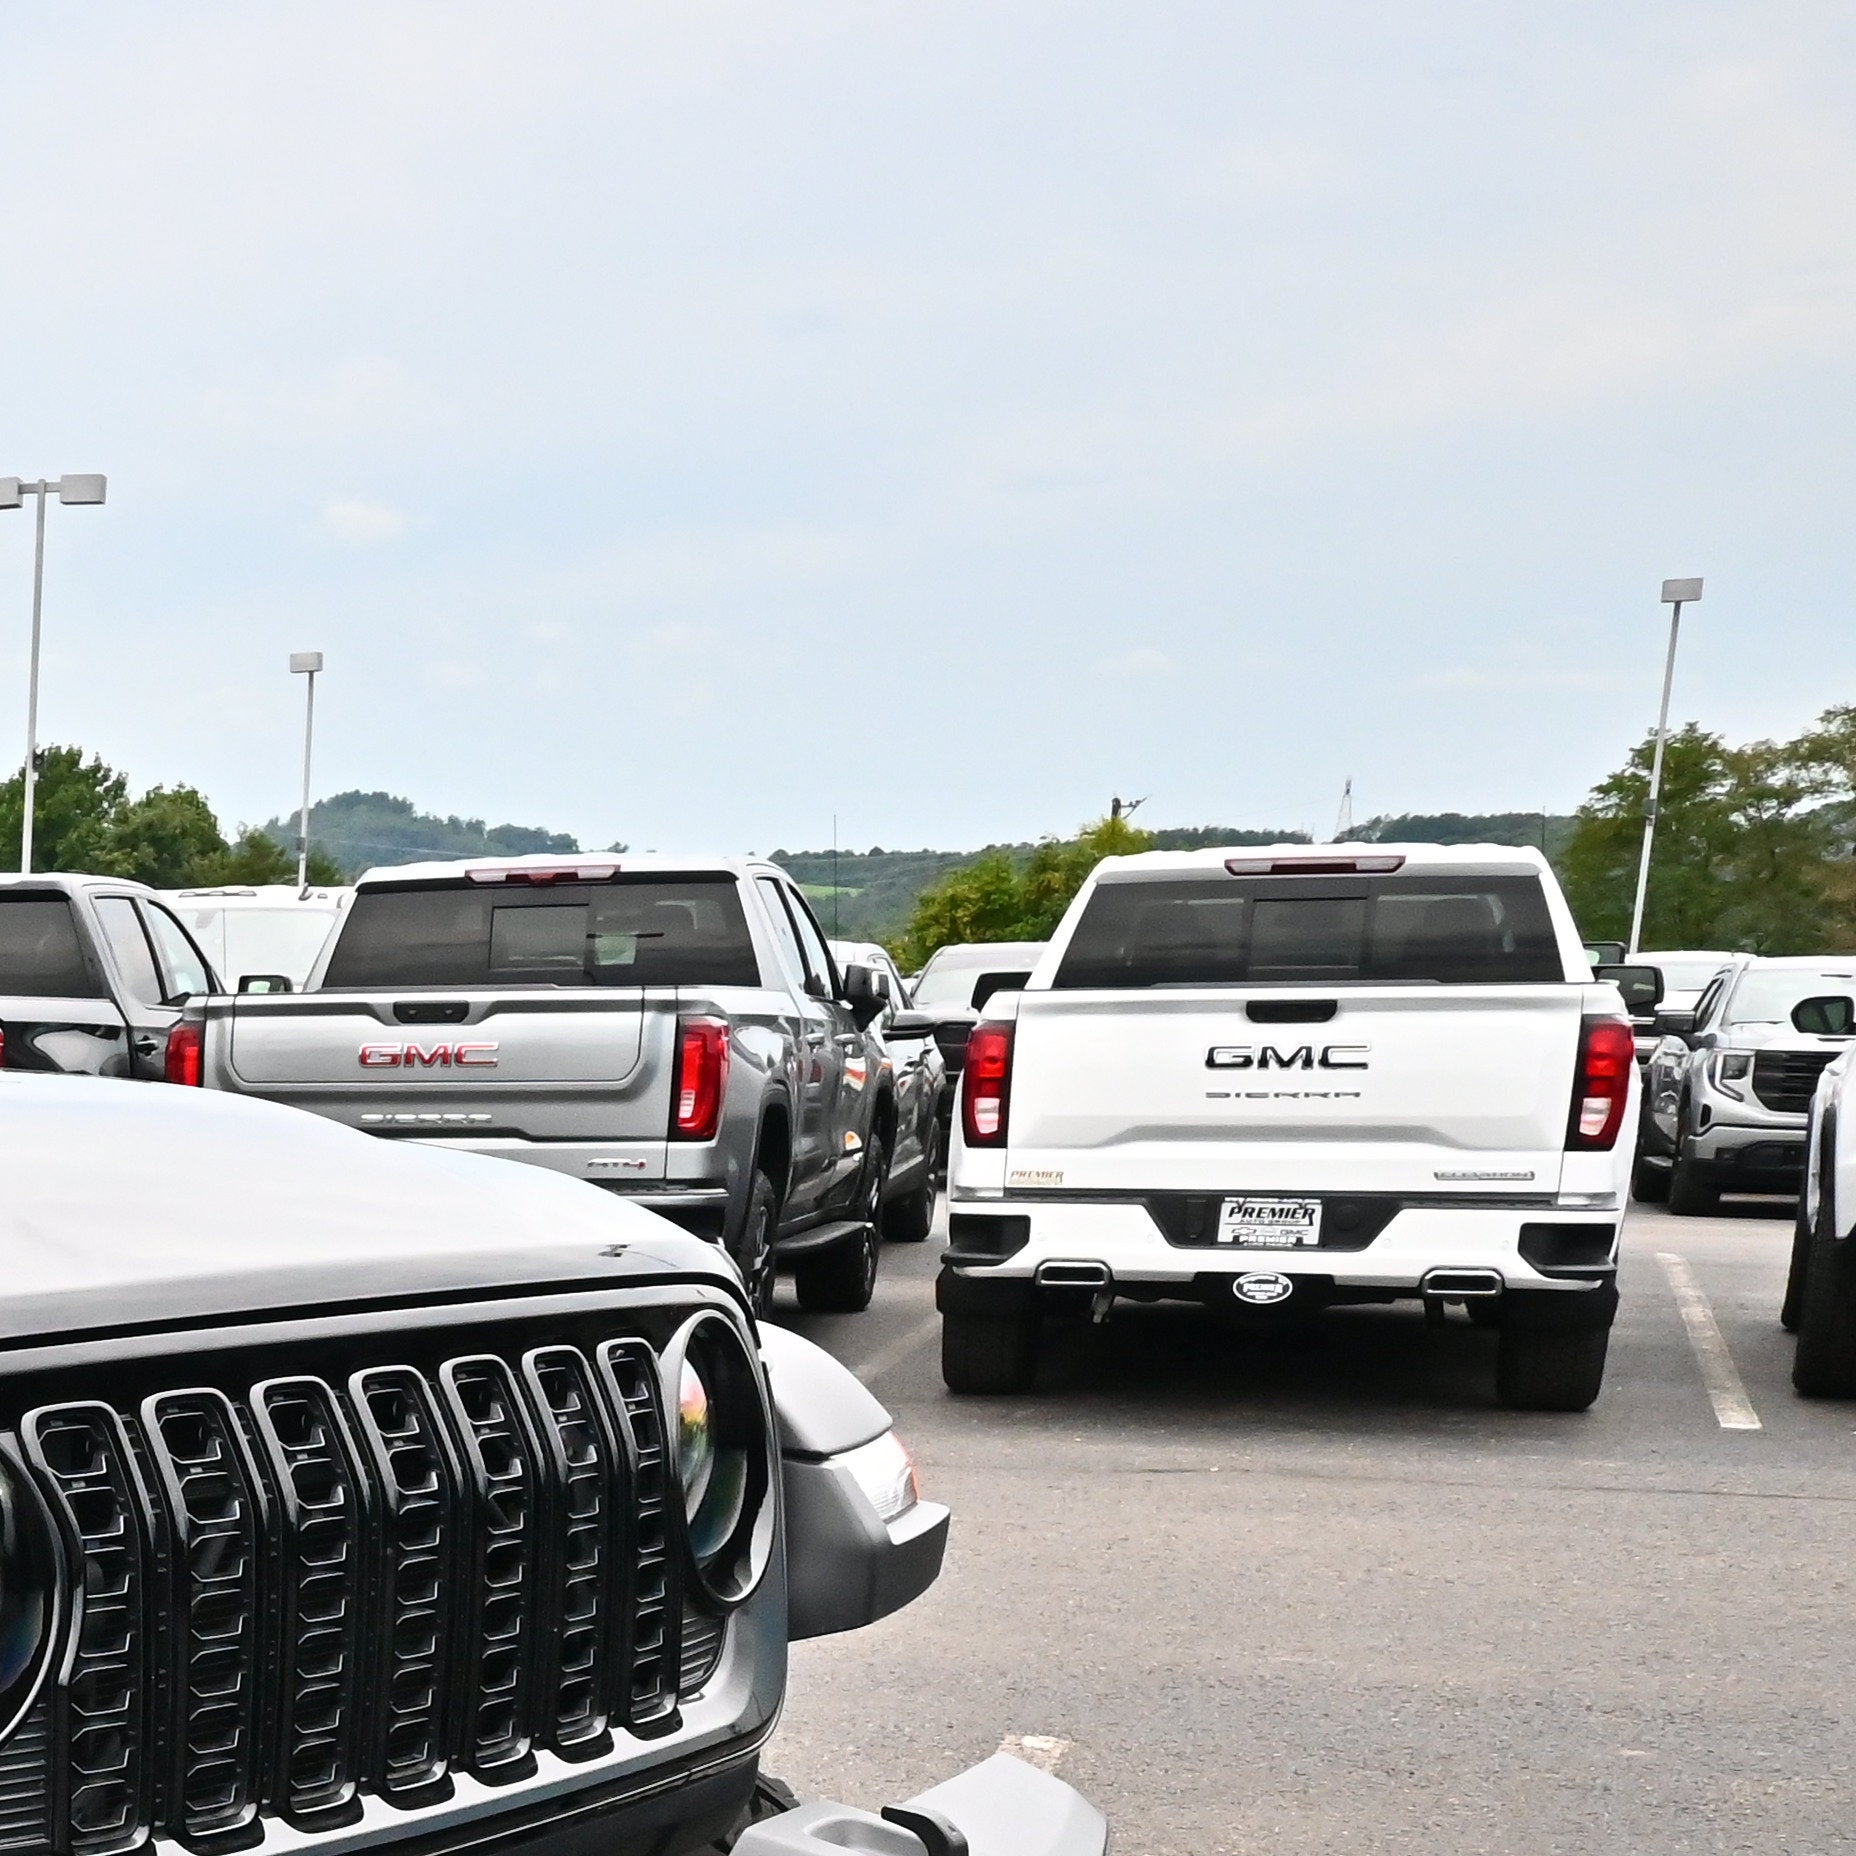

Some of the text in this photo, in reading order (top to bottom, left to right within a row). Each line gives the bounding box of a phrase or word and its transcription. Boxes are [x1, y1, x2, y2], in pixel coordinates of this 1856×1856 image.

[359, 1042, 499, 1067] GMC
[1204, 1044, 1370, 1070] GMC
[1228, 1206, 1316, 1226] PREMIER
